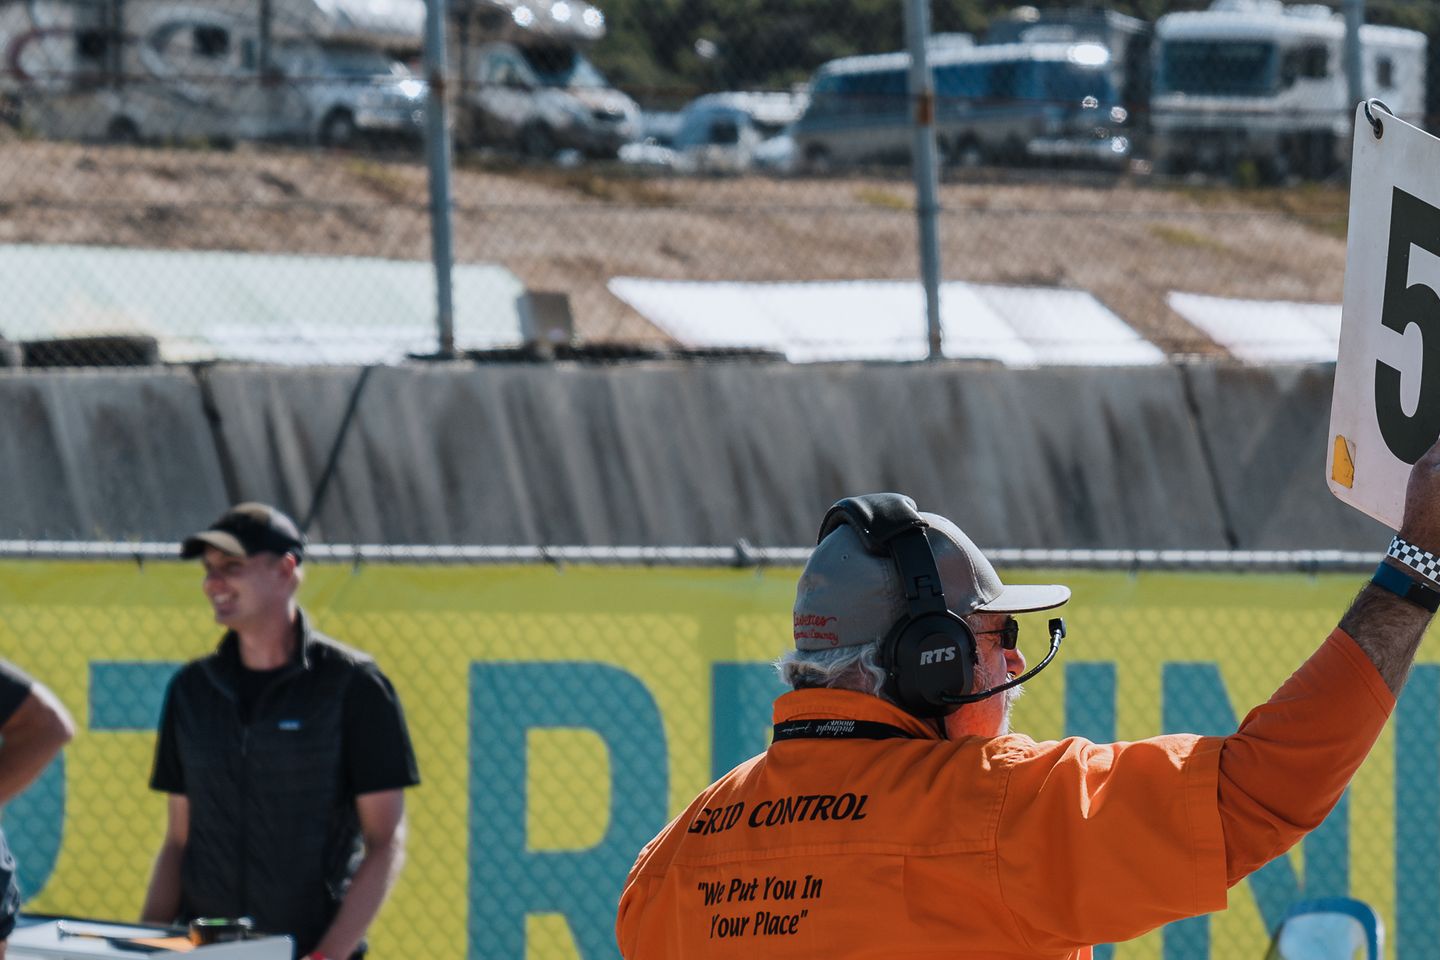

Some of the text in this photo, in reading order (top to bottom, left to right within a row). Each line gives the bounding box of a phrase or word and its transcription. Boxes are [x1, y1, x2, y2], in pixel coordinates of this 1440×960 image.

[919, 646, 956, 666] RTS
[687, 792, 869, 836] GRID CONTROL
[697, 874, 824, 907] "We Put You In
[710, 909, 809, 939] Your Place"
